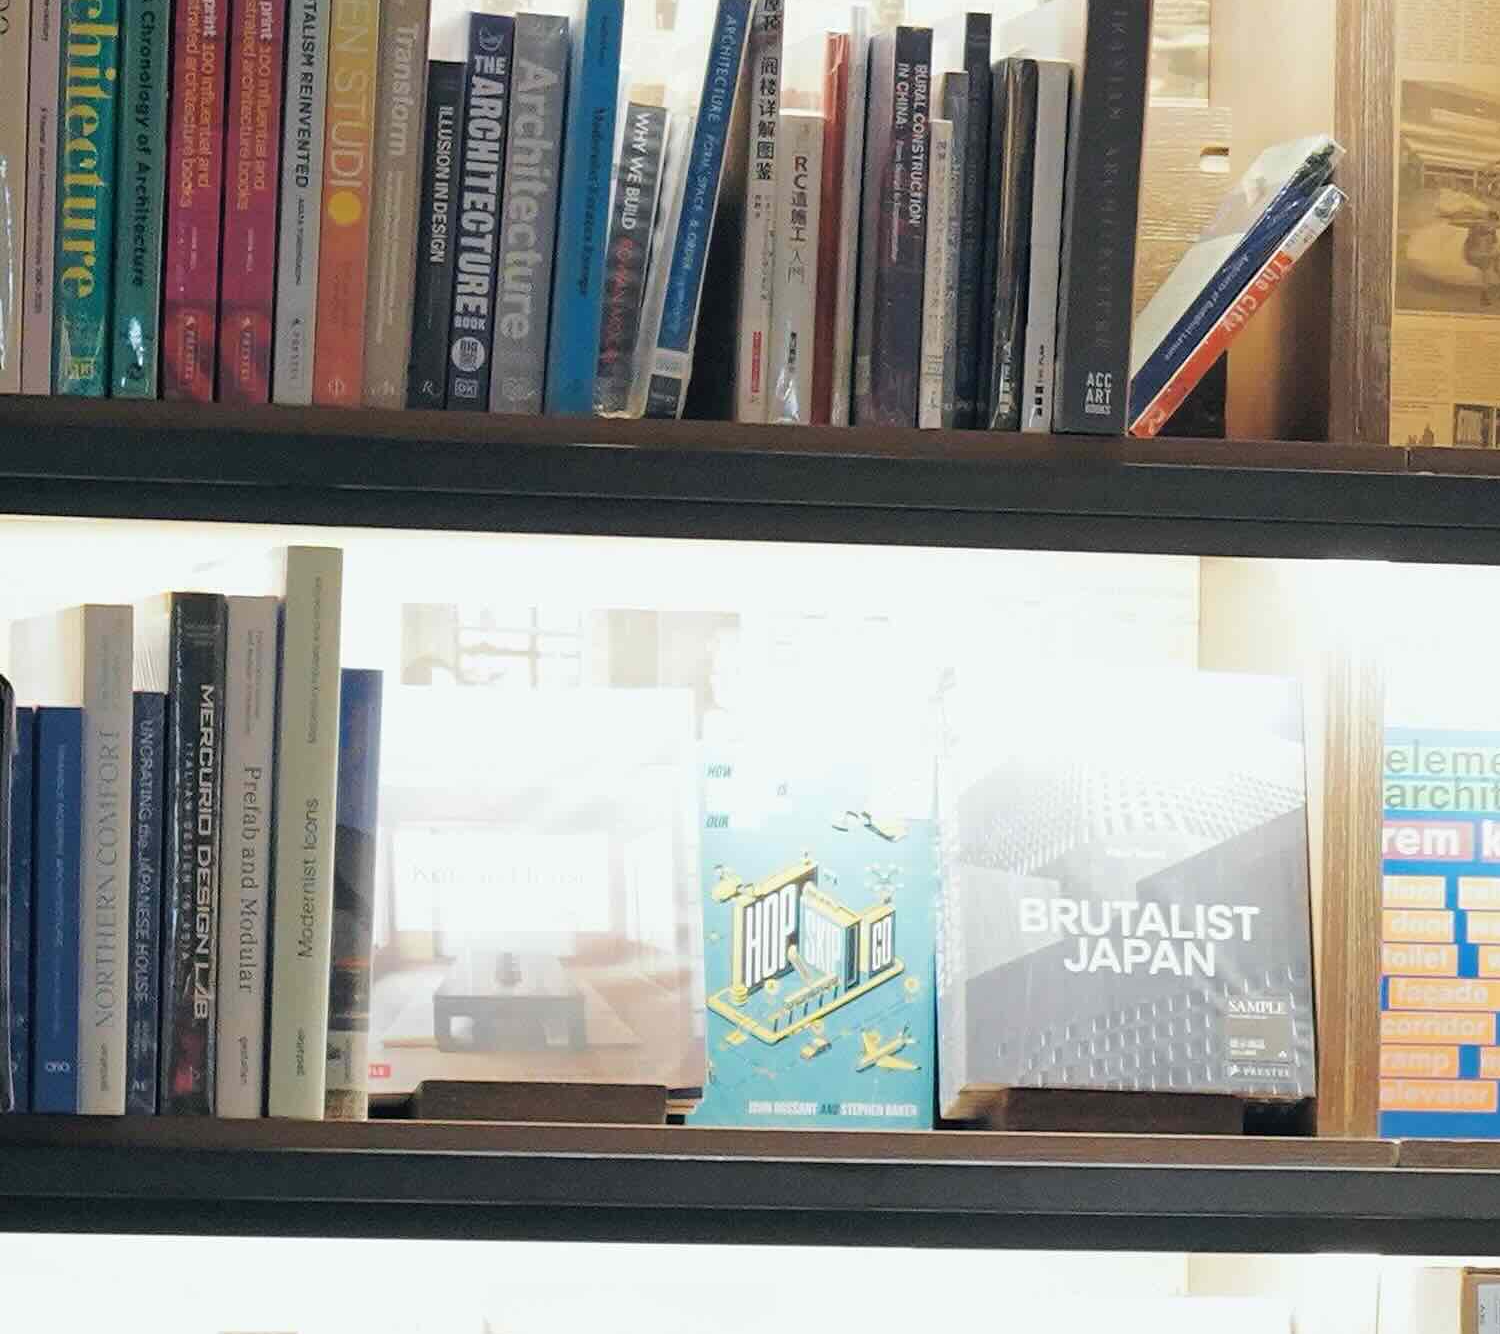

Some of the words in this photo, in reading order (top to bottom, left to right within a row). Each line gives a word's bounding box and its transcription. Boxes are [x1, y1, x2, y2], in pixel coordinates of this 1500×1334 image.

[135, 10, 154, 132] Chronology
[388, 24, 418, 156] Transform
[475, 55, 505, 75] THE
[897, 63, 908, 78] IN
[916, 63, 928, 106] RURAL
[138, 133, 151, 155] of
[295, 72, 313, 187] REINVENTED
[436, 106, 453, 180] ILLUSION
[635, 113, 651, 158] WHY
[434, 181, 450, 202] IN
[629, 158, 645, 185] WE
[908, 109, 928, 226] CONSTRUCTION
[130, 160, 152, 288] Architecture
[454, 77, 504, 317] ARCHITECTURE
[501, 66, 558, 340] Architecture
[622, 187, 641, 230] BUILD
[431, 203, 450, 264] DESIGN
[1255, 253, 1295, 293] The
[1222, 293, 1262, 332] City
[1086, 372, 1112, 388] ACC
[1086, 391, 1112, 404] ART
[198, 683, 214, 836] MERCURIO
[97, 731, 119, 869] COMFORT
[243, 766, 262, 842] Prefab
[302, 799, 319, 856] Icons
[241, 847, 257, 889] and
[1382, 825, 1460, 856] rem
[195, 845, 212, 953] DESIGN
[298, 862, 319, 959] Modernist
[1018, 896, 1259, 943] BRUTALIST
[95, 878, 117, 1029] NORTHERN
[238, 895, 258, 996] Modular
[745, 884, 797, 987] HOP
[1063, 935, 1215, 977] JAPAN
[1228, 999, 1286, 1015] SAMPLE
